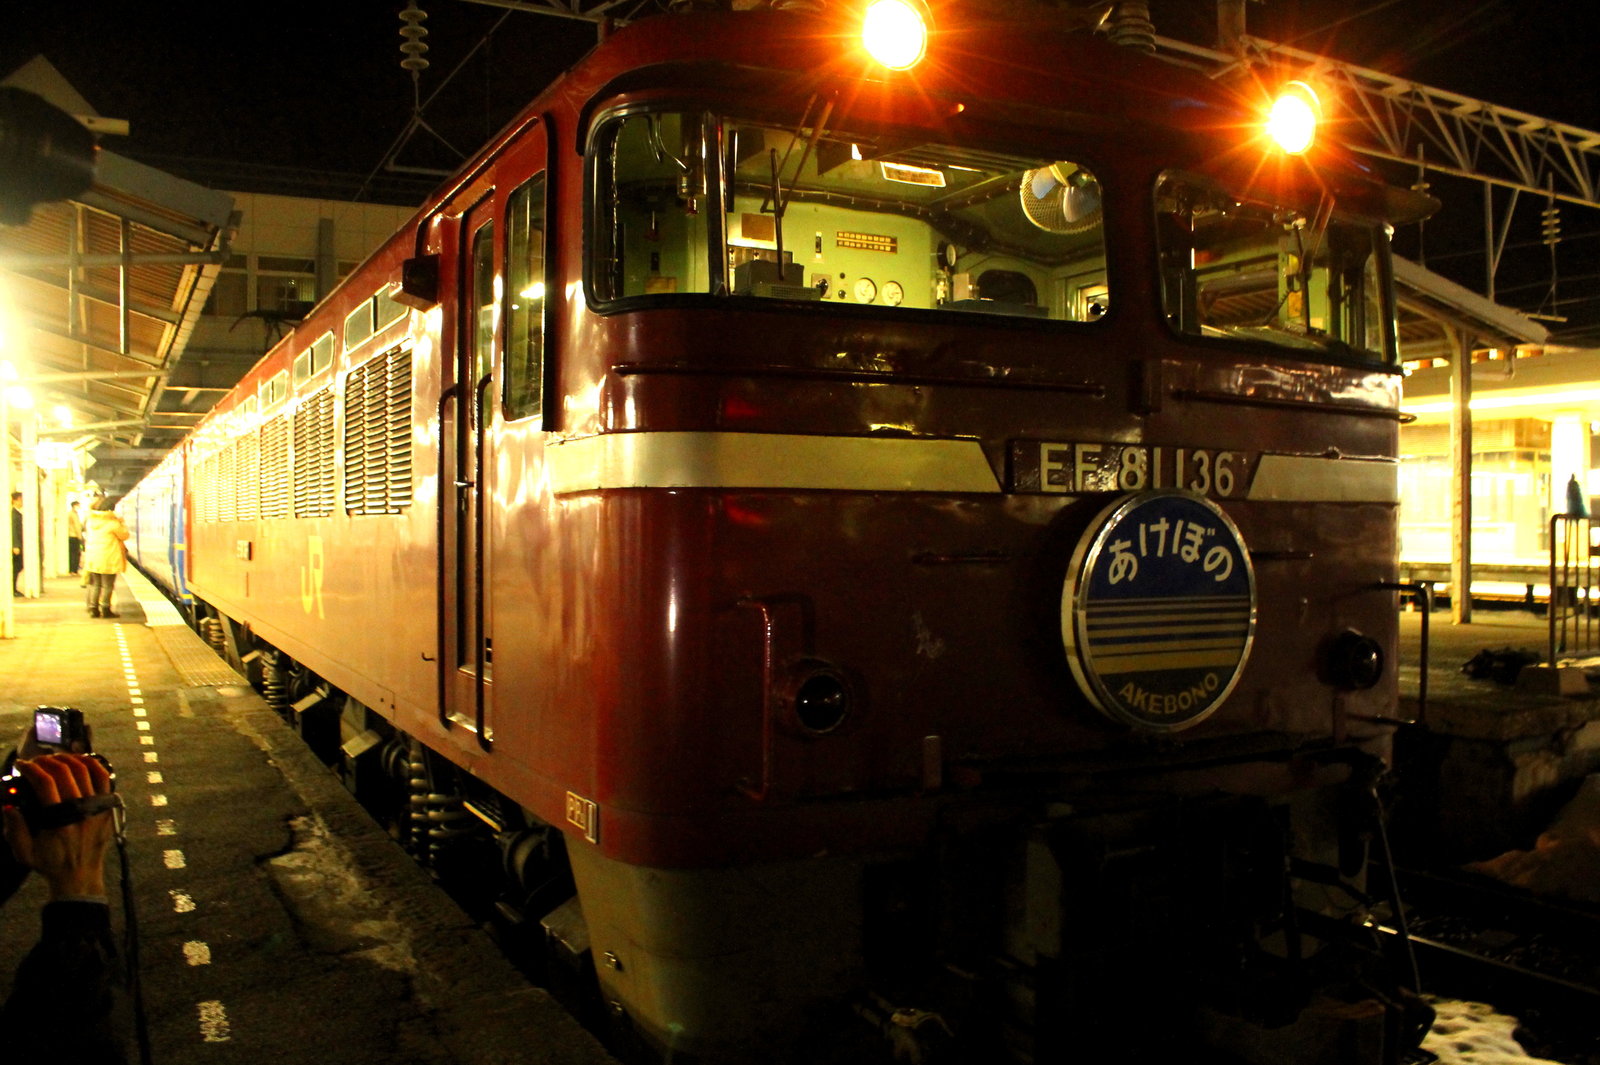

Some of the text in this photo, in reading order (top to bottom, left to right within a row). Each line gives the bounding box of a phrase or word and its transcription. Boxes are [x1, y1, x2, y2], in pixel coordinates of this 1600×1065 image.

[1040, 442, 1103, 493] EF
[1108, 517, 1234, 586] あけぼの
[1118, 672, 1220, 715] AKEBONO
